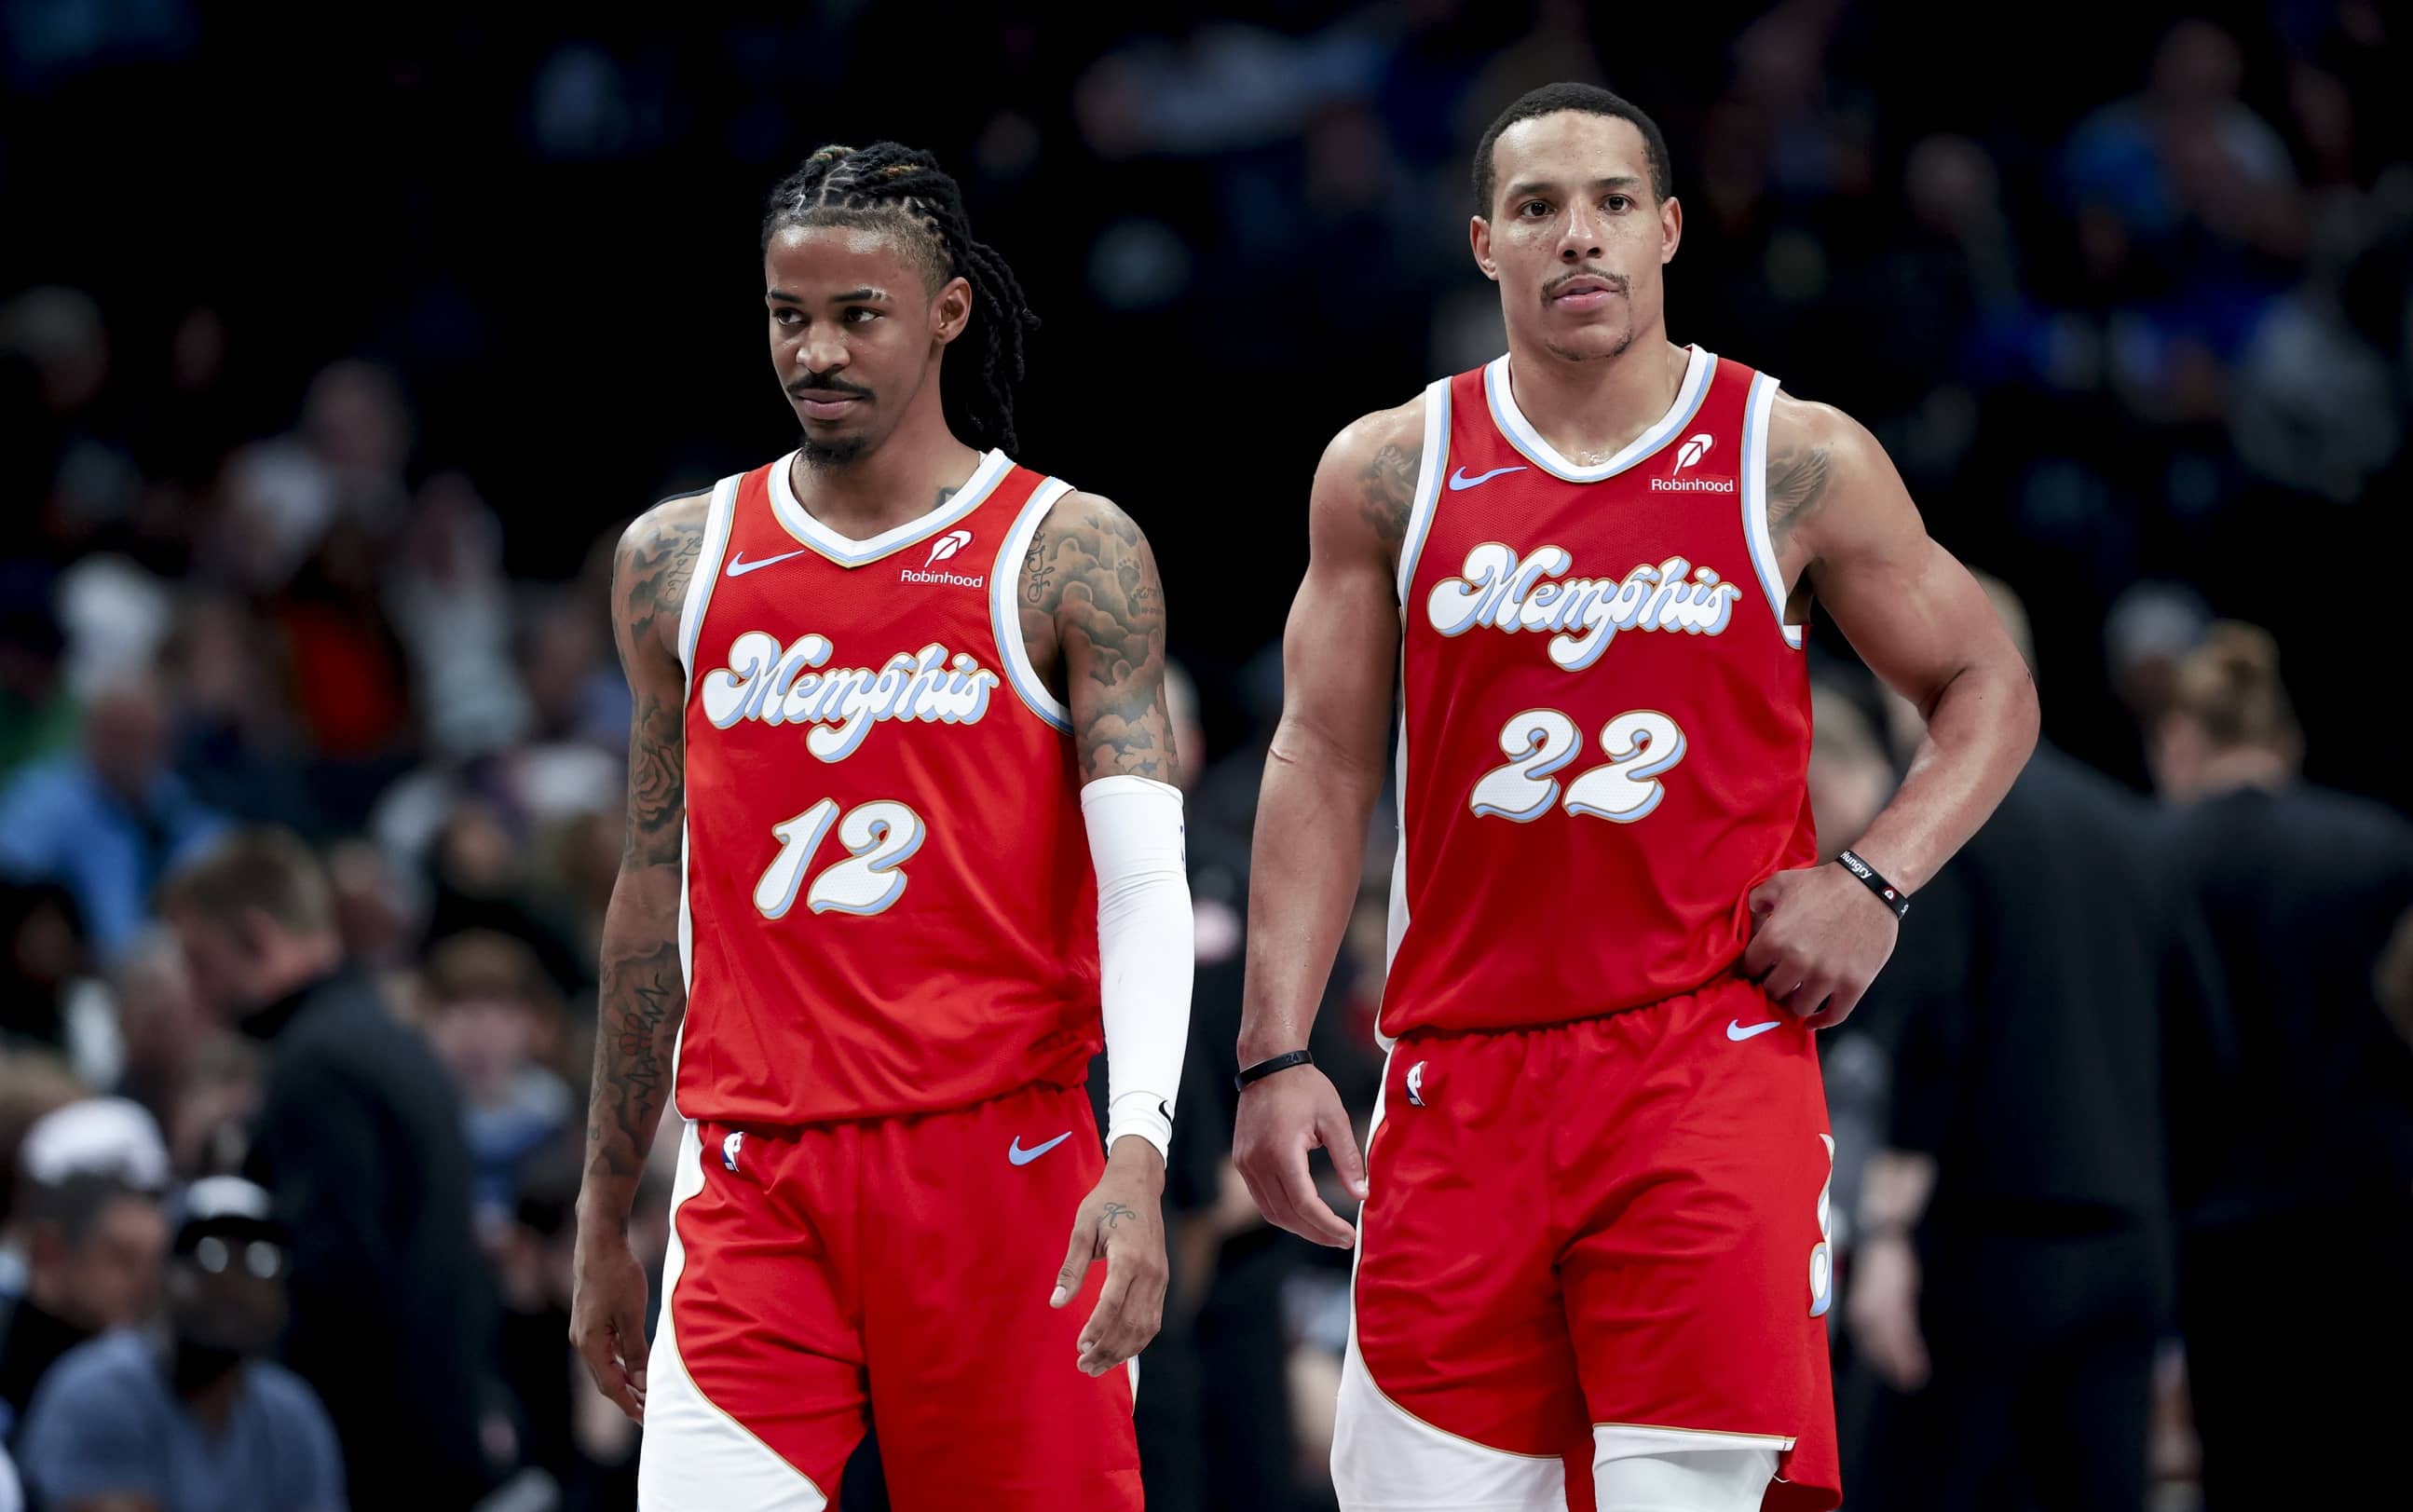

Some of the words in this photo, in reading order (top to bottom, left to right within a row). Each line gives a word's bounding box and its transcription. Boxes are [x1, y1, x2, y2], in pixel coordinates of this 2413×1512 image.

[1651, 478, 1734, 492] Robinhood
[900, 569, 984, 588] Robinhood
[1426, 541, 1742, 672] Memphis
[702, 631, 1000, 763] Memphis
[1469, 707, 1687, 824] 22
[753, 797, 926, 919] 12
[1840, 851, 1873, 879] Hungry
